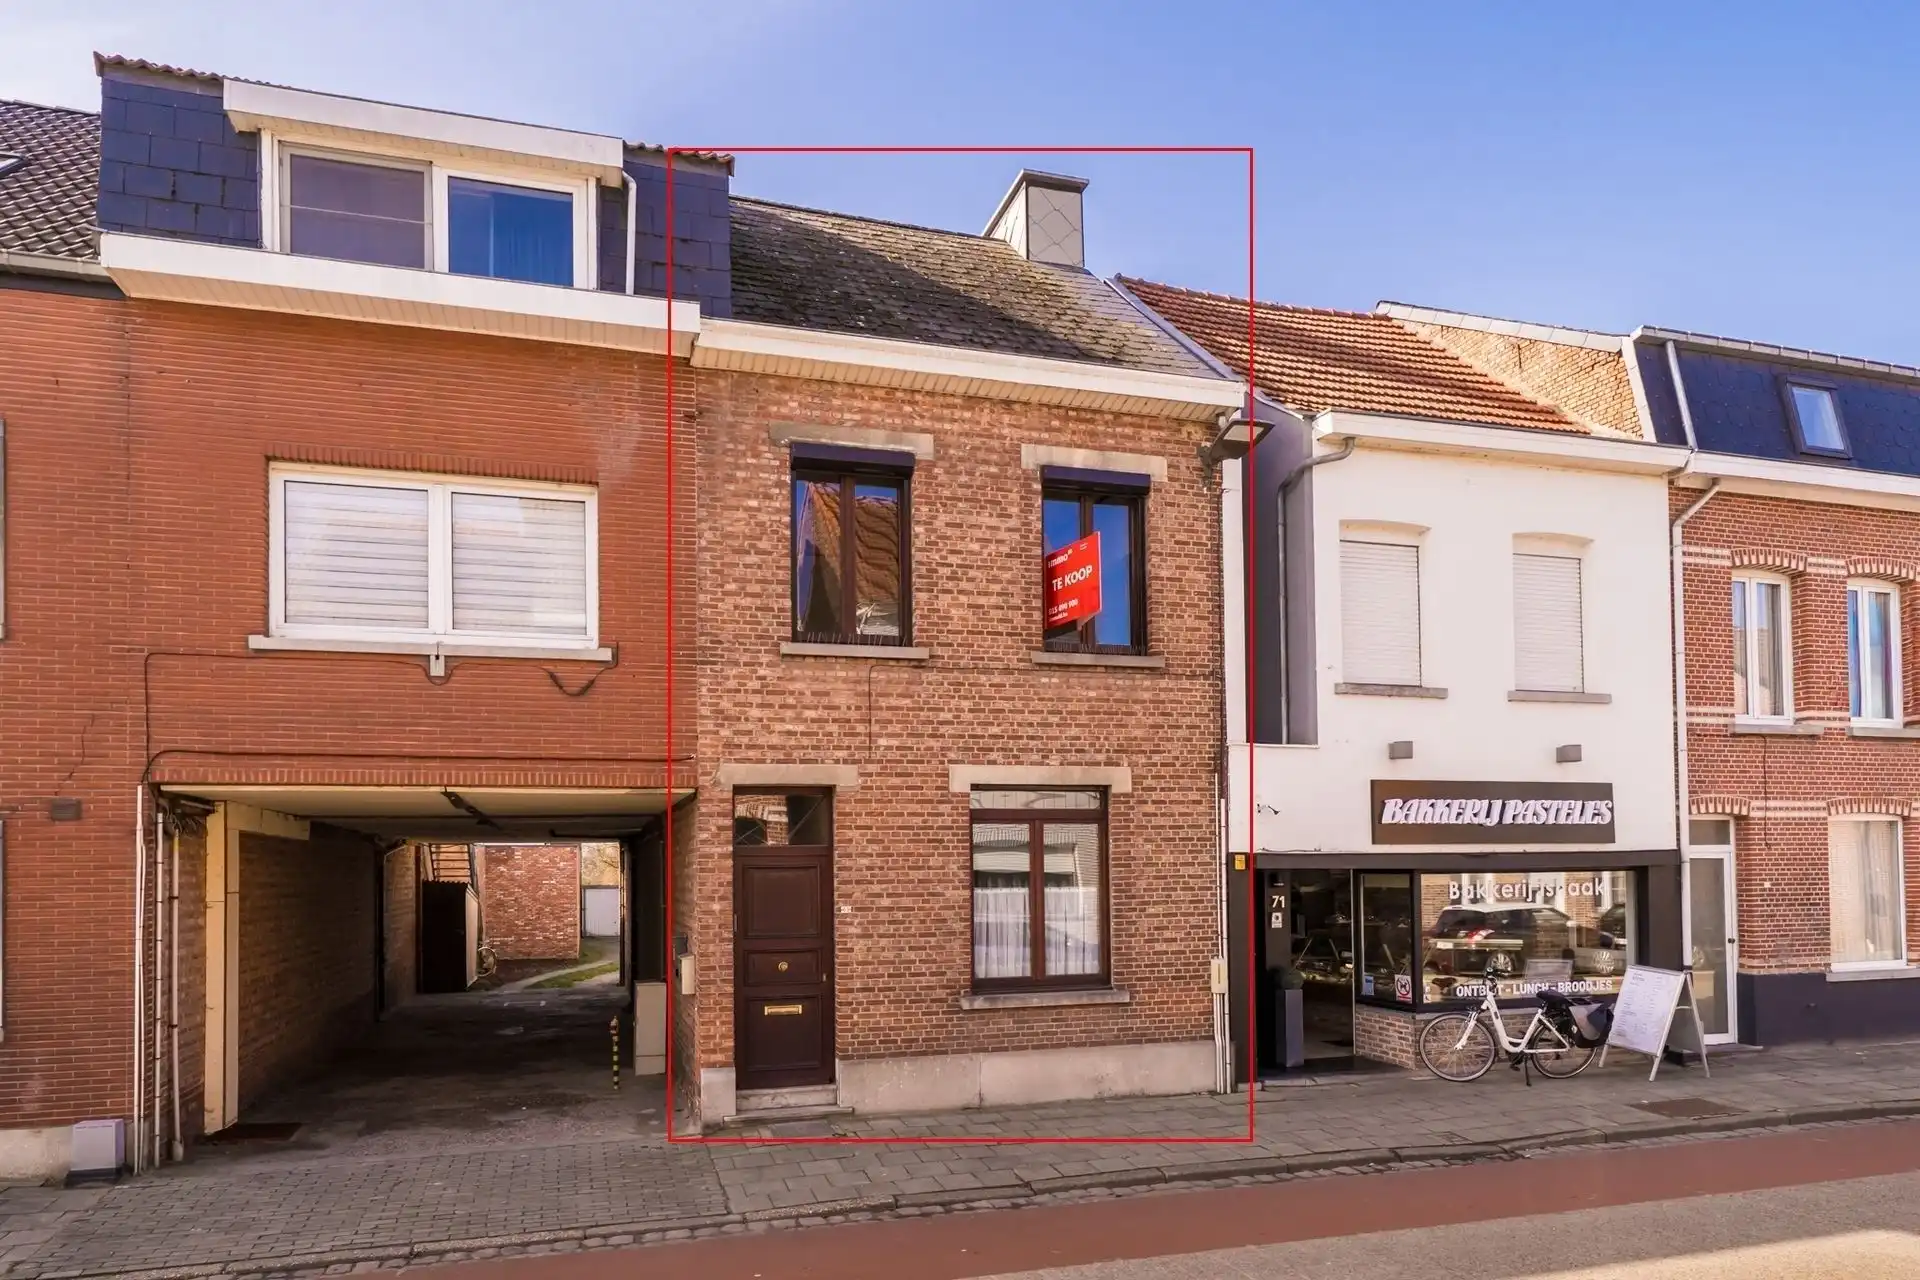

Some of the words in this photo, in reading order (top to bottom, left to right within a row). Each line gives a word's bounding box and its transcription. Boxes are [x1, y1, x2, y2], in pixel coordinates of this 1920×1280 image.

[1052, 577, 1063, 591] TE
[1064, 564, 1093, 587] KOOP
[1382, 799, 1500, 826] BAKKERIJ
[1502, 799, 1613, 825] PASTELES
[1272, 895, 1285, 908] 71
[1449, 878, 1533, 902] Bakkerij
[1513, 982, 1549, 995] LUNCH
[1557, 980, 1612, 993] BROODJES
